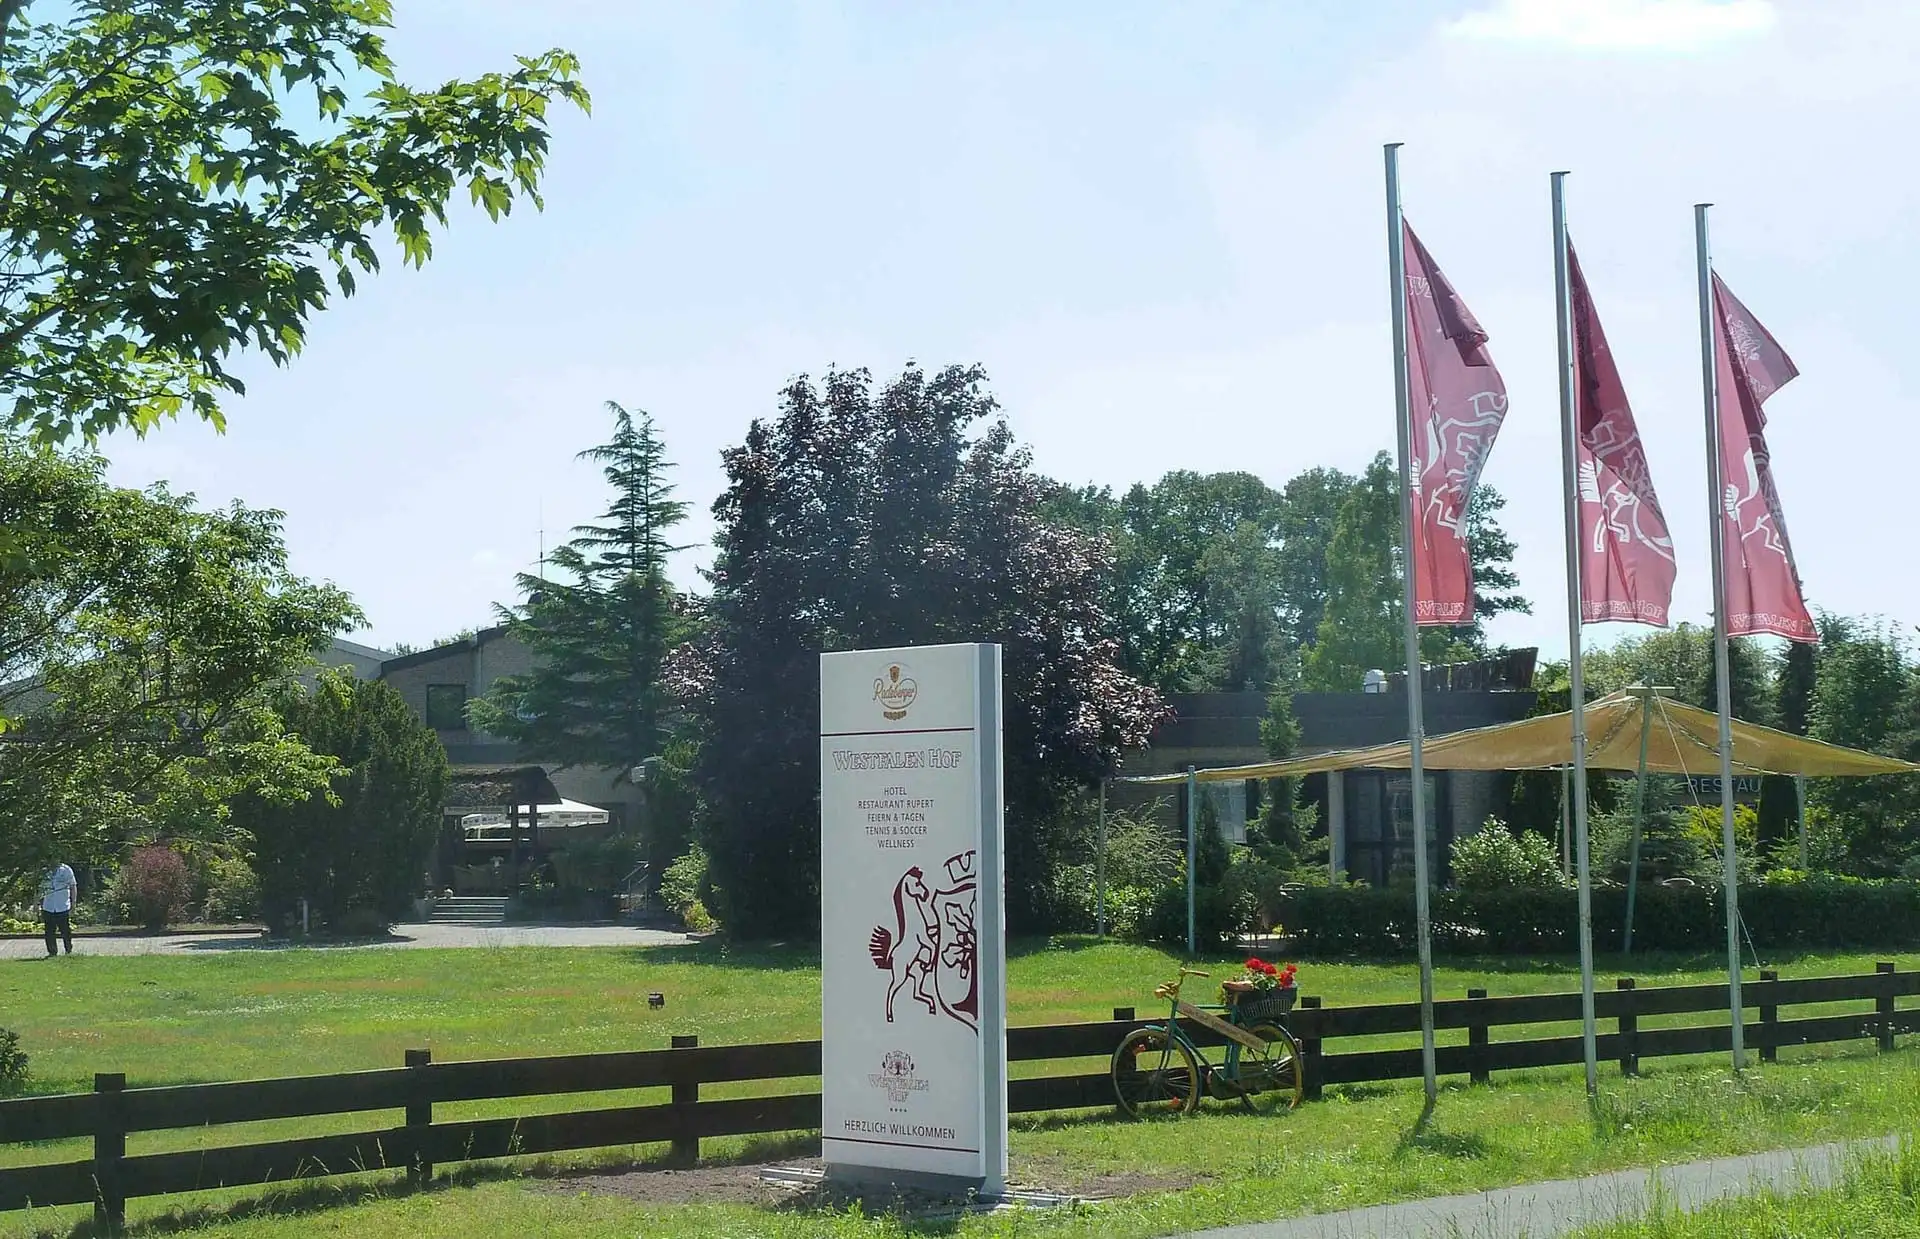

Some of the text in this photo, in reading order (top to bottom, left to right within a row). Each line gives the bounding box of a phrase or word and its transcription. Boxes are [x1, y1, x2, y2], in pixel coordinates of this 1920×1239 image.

[832, 747, 962, 770] WESTFALEN HOF
[884, 786, 907, 796] HOTEL
[858, 799, 934, 809] RESTAURANT RUPERT
[867, 812, 925, 822] FEIERN & TAGEN
[865, 825, 928, 835] TENNIS & SOCCER
[877, 839, 915, 849] WELLNESS
[844, 1119, 955, 1140] HERZLICH WILLKOMMEN
